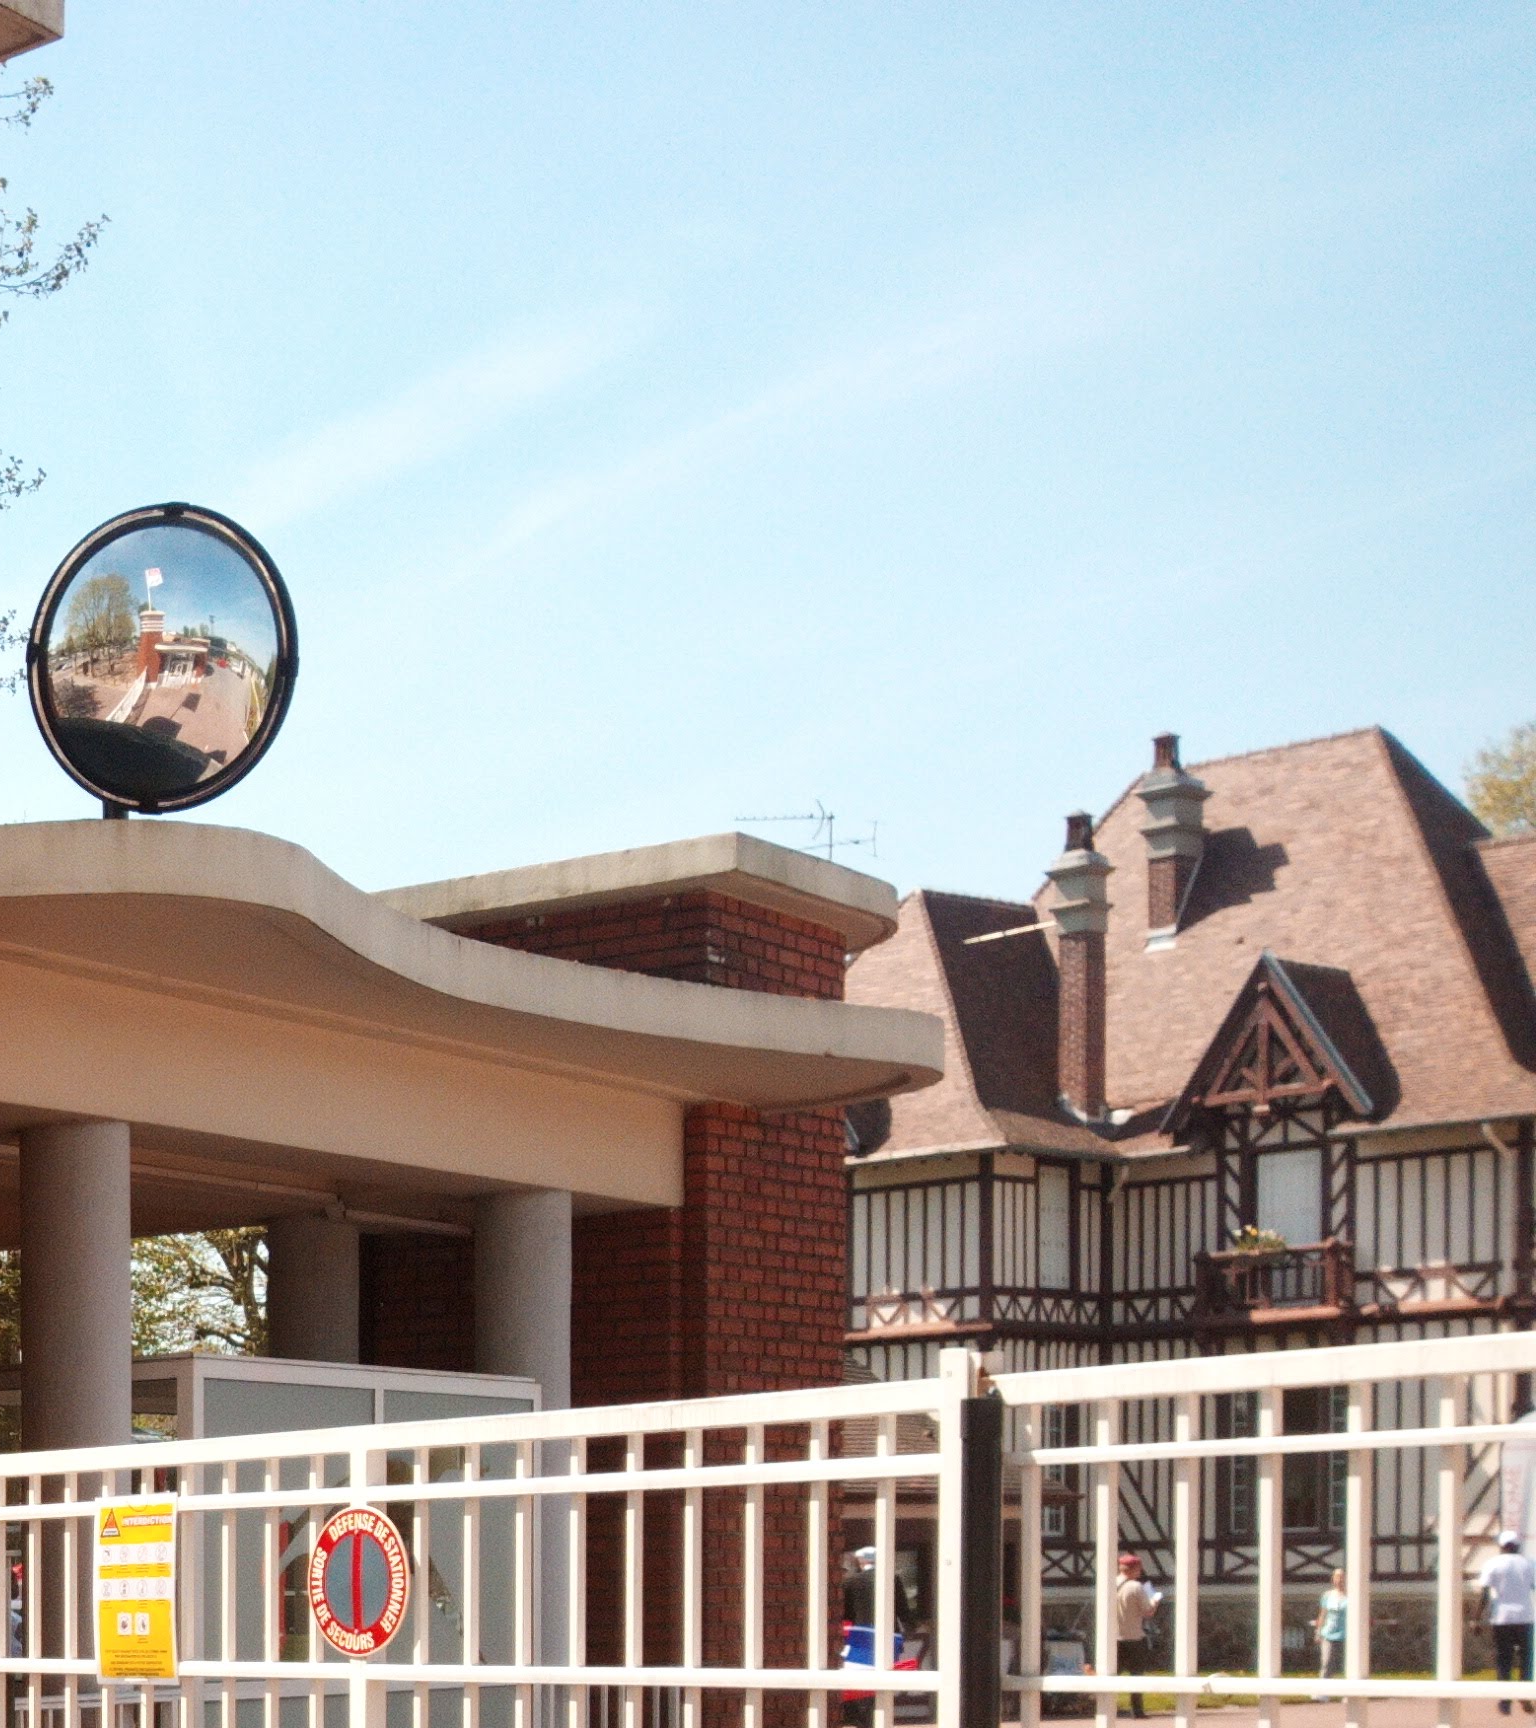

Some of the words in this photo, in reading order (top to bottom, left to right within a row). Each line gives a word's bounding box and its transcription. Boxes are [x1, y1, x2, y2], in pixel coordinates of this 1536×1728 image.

[373, 1520, 390, 1543] DE
[311, 1547, 328, 1604] SORTIE
[380, 1536, 405, 1633] STATIONNER
[316, 1603, 331, 1627] DE
[327, 1621, 375, 1651] SECOURS
